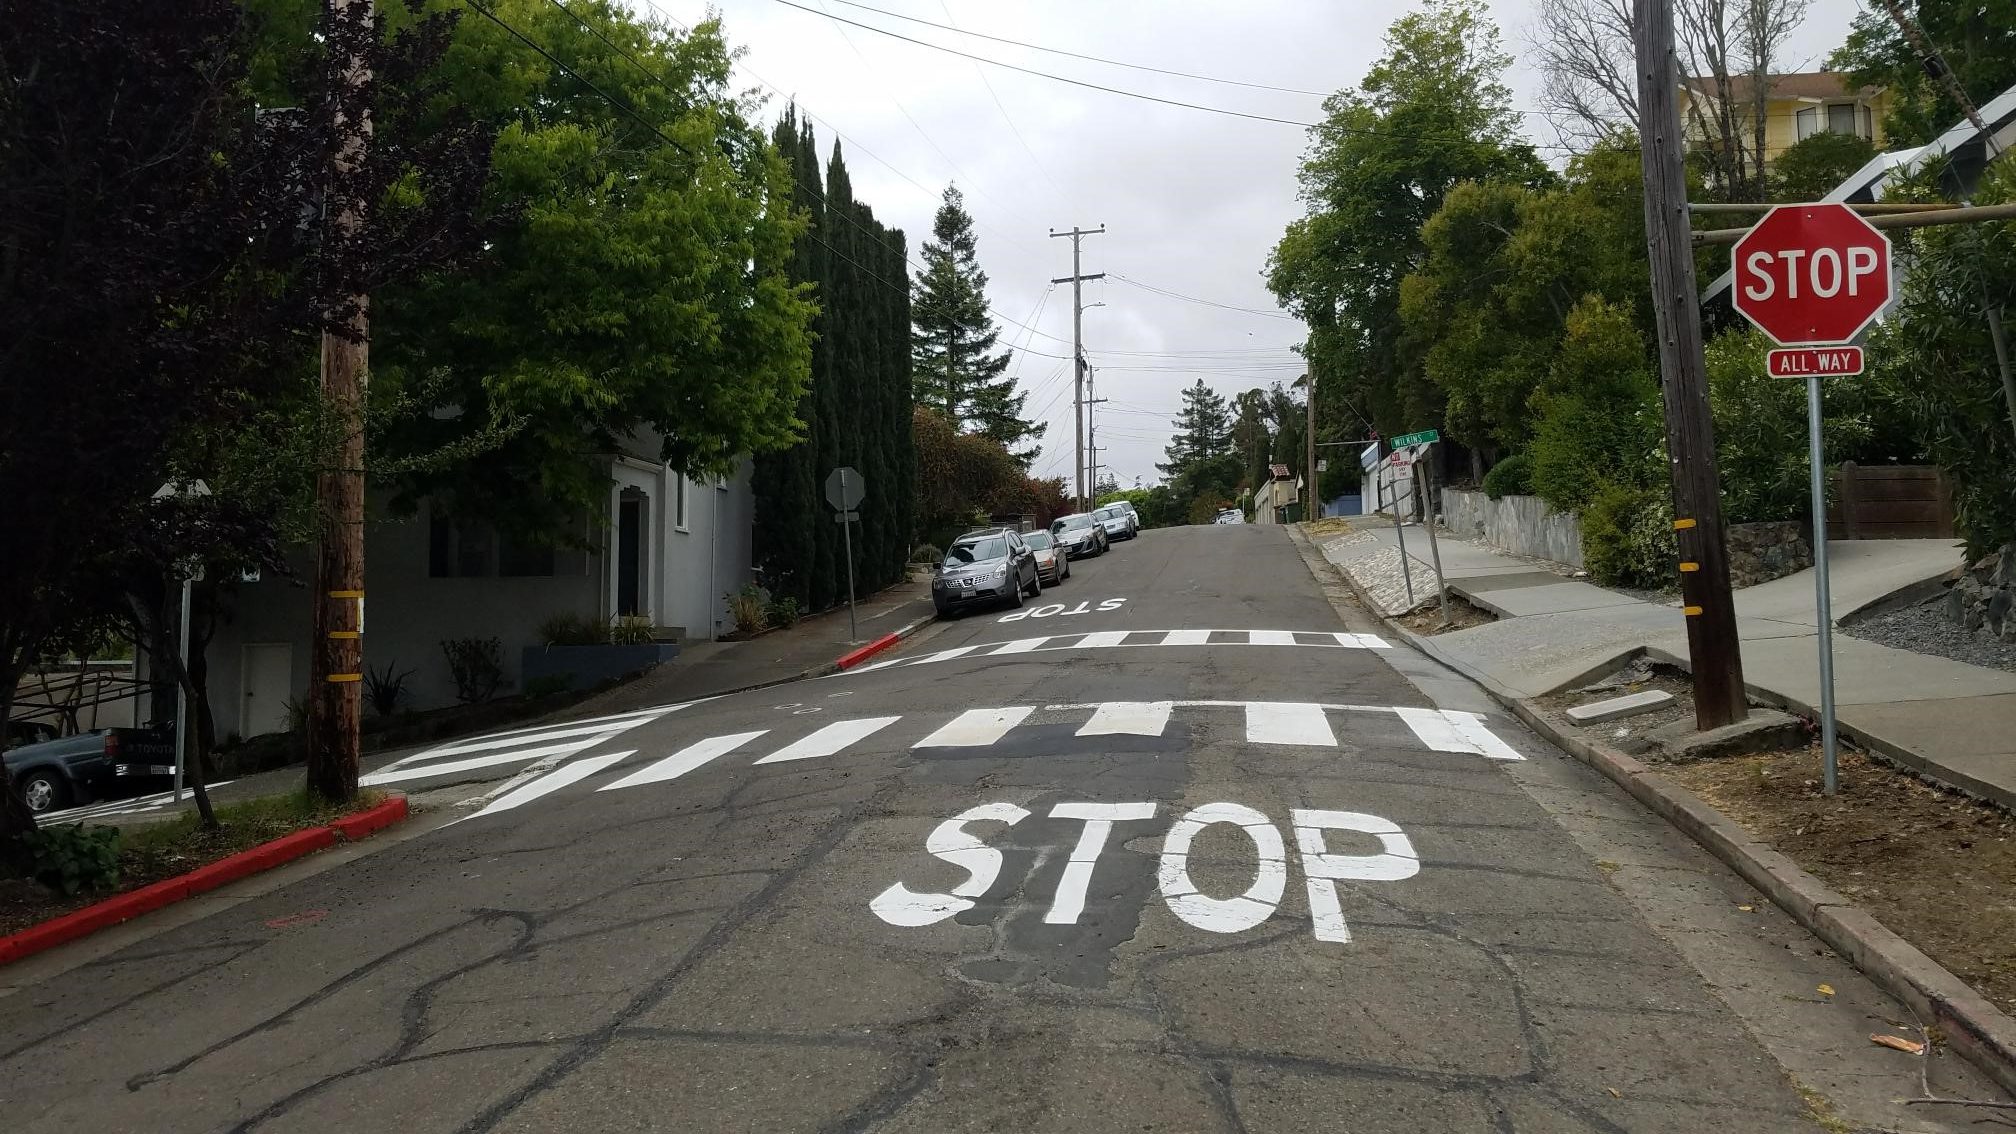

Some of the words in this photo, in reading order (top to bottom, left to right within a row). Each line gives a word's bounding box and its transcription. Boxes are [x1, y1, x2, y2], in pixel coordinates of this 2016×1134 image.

[1745, 247, 1878, 301] STOP
[1780, 354, 1810, 373] ALL
[1817, 352, 1851, 371] WAY
[1394, 434, 1423, 447] WILKINS
[997, 598, 1127, 623] STOP
[137, 744, 175, 754] TOYOTA
[869, 802, 1420, 943] STOP
